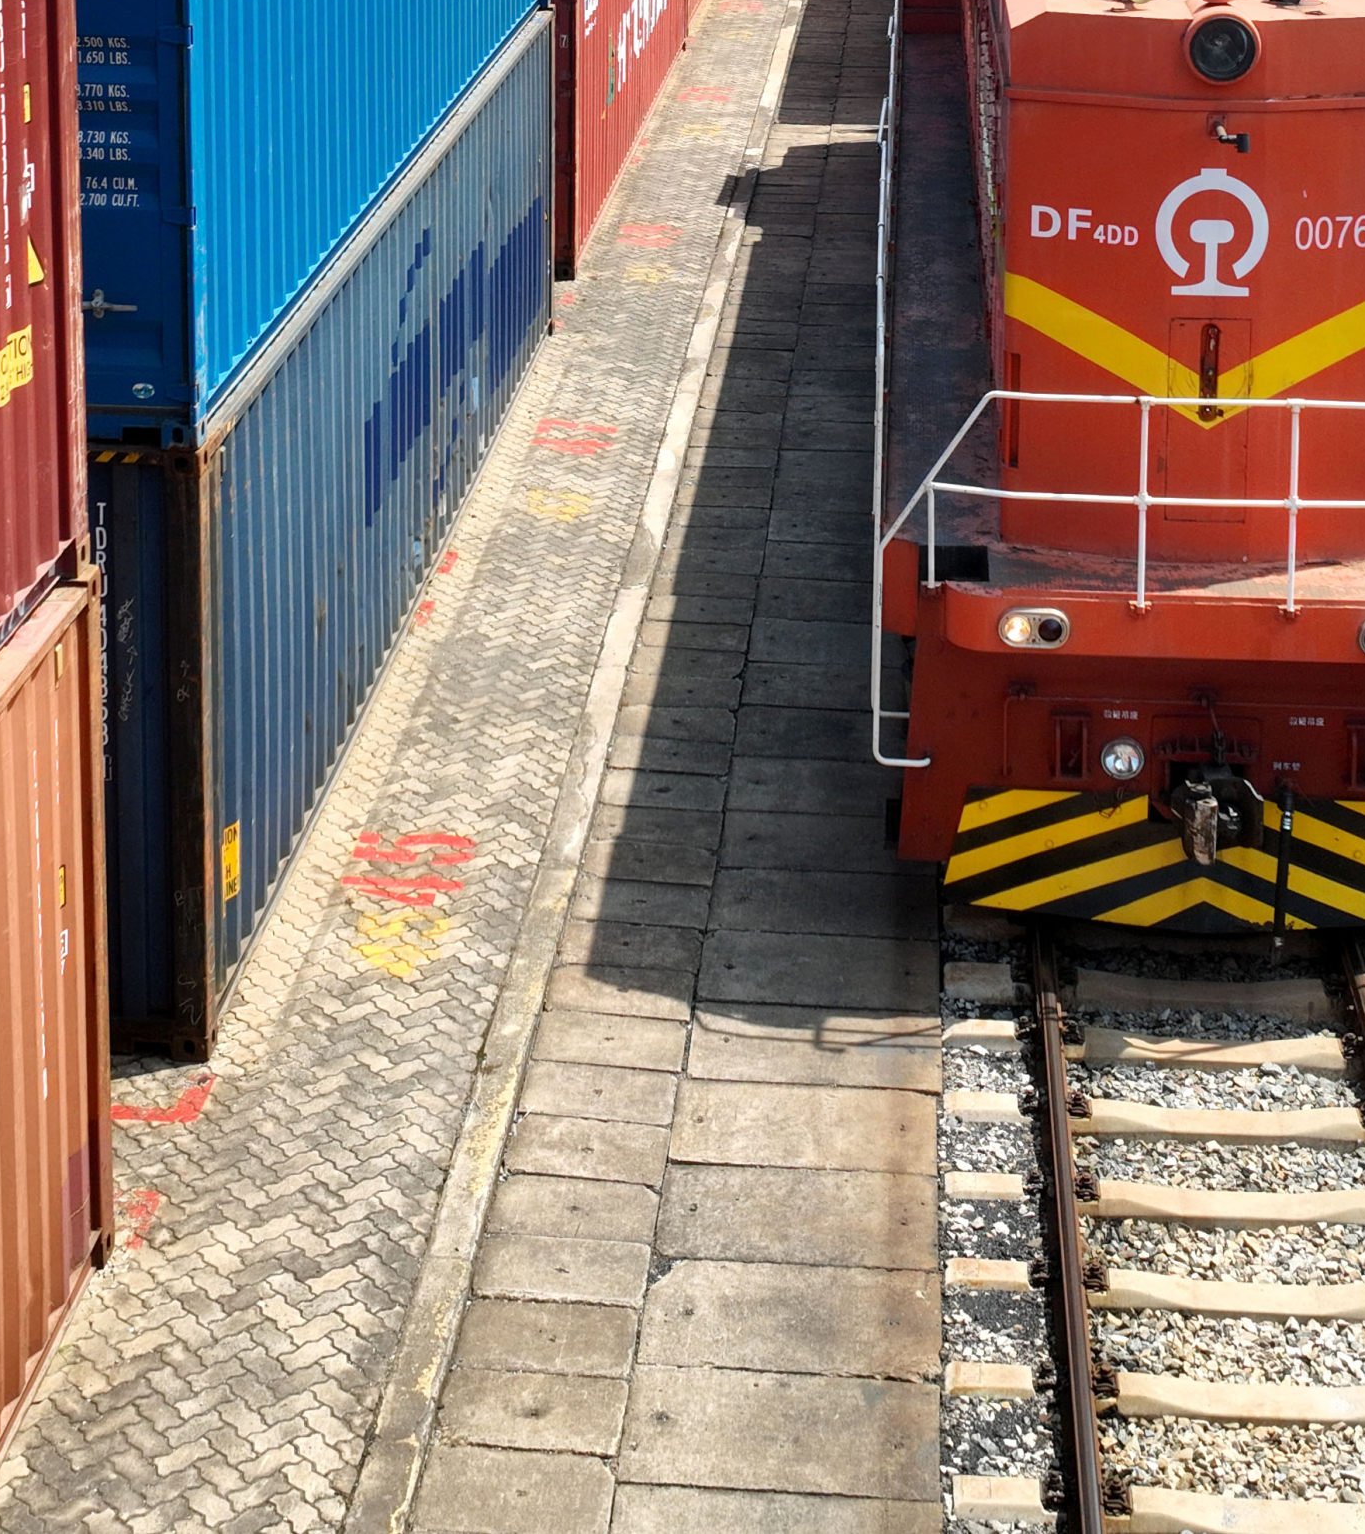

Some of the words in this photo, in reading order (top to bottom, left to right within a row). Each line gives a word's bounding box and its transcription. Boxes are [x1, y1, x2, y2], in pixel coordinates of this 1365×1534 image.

[107, 37, 130, 48] KGS.
[109, 52, 131, 65] LBS.
[108, 85, 130, 98] KGS.
[110, 100, 132, 112] LBS.
[110, 132, 131, 144] KGS.
[110, 149, 131, 161] LBS.
[85, 177, 107, 189] 76.4
[113, 178, 138, 190] CU.M.
